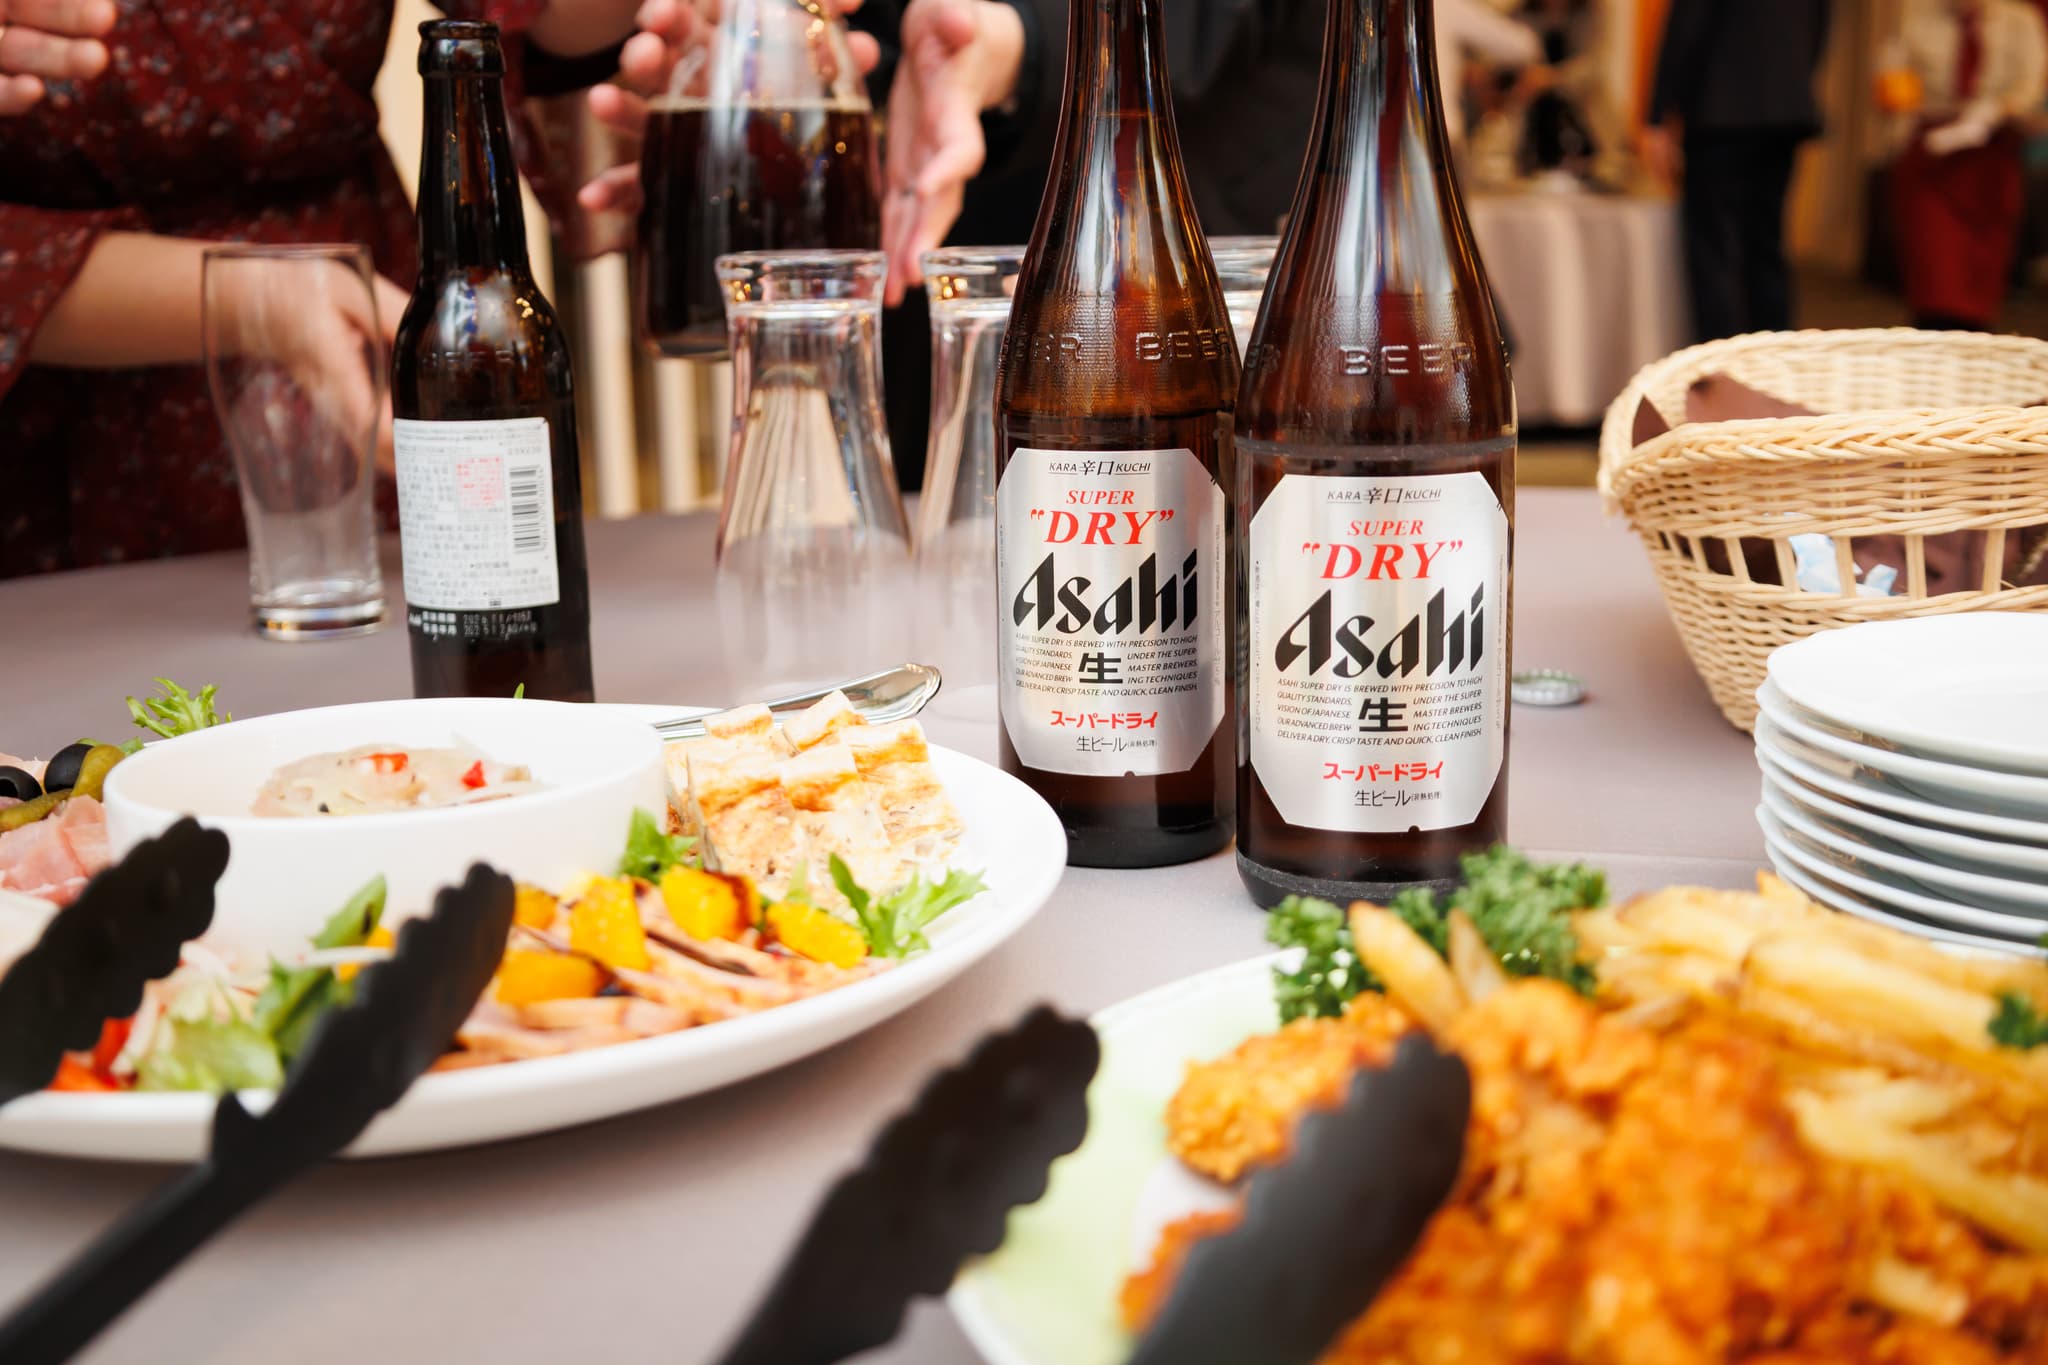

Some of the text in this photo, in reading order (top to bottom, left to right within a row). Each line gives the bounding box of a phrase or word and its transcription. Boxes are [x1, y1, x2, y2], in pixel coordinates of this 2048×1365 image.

[1339, 343, 1472, 375] BEER
[1049, 460, 1151, 476] KARA 辛口 KUCHI
[1066, 490, 1136, 505] SUPER
[1327, 487, 1442, 504] KARA 辛口 KUCHI
[1347, 519, 1424, 536] SUPER
[1013, 549, 1198, 635] Asahi
[1274, 581, 1484, 679] Asahi
[1051, 638, 1064, 646] DRY
[1074, 640, 1104, 648] BREWED
[1107, 640, 1126, 648] WITH
[1129, 638, 1168, 648] PRECISION
[1127, 652, 1155, 660] UNDER
[1158, 650, 1172, 658] THE
[1040, 660, 1072, 671] JAPANESE
[1079, 652, 1123, 684] 生
[1128, 663, 1161, 672] MASTER
[1128, 671, 1198, 684] ING TECHNIQUES
[1278, 678, 1298, 687] ASAHI
[1300, 681, 1324, 690] SUPER
[1326, 683, 1342, 691] DRY
[1353, 684, 1389, 693] BREWED
[1391, 684, 1413, 693] WITH
[1415, 680, 1455, 692] PRECISION
[1457, 678, 1466, 687] TO
[1467, 675, 1483, 685] HIGH
[1078, 688, 1099, 697] TASTE
[1149, 686, 1174, 695] CLEAN
[1277, 692, 1305, 702] QUALITY
[1413, 696, 1442, 705] UNDER
[1445, 693, 1459, 702] THE
[1050, 710, 1158, 729] スーパードライ
[1277, 704, 1351, 719] VISION OF JAPANESE
[1359, 697, 1408, 732] 生
[1413, 708, 1448, 718] MASTER
[1290, 719, 1328, 730] ADVANCED
[1413, 715, 1482, 731] ING TECHNIQUES
[1277, 730, 1306, 741] DELIVER
[1331, 736, 1356, 745] CRISP
[1357, 737, 1383, 746] TASTE
[1384, 737, 1404, 746] AND
[1435, 732, 1460, 743] CLEAN
[1322, 761, 1444, 782] スーパードライ
